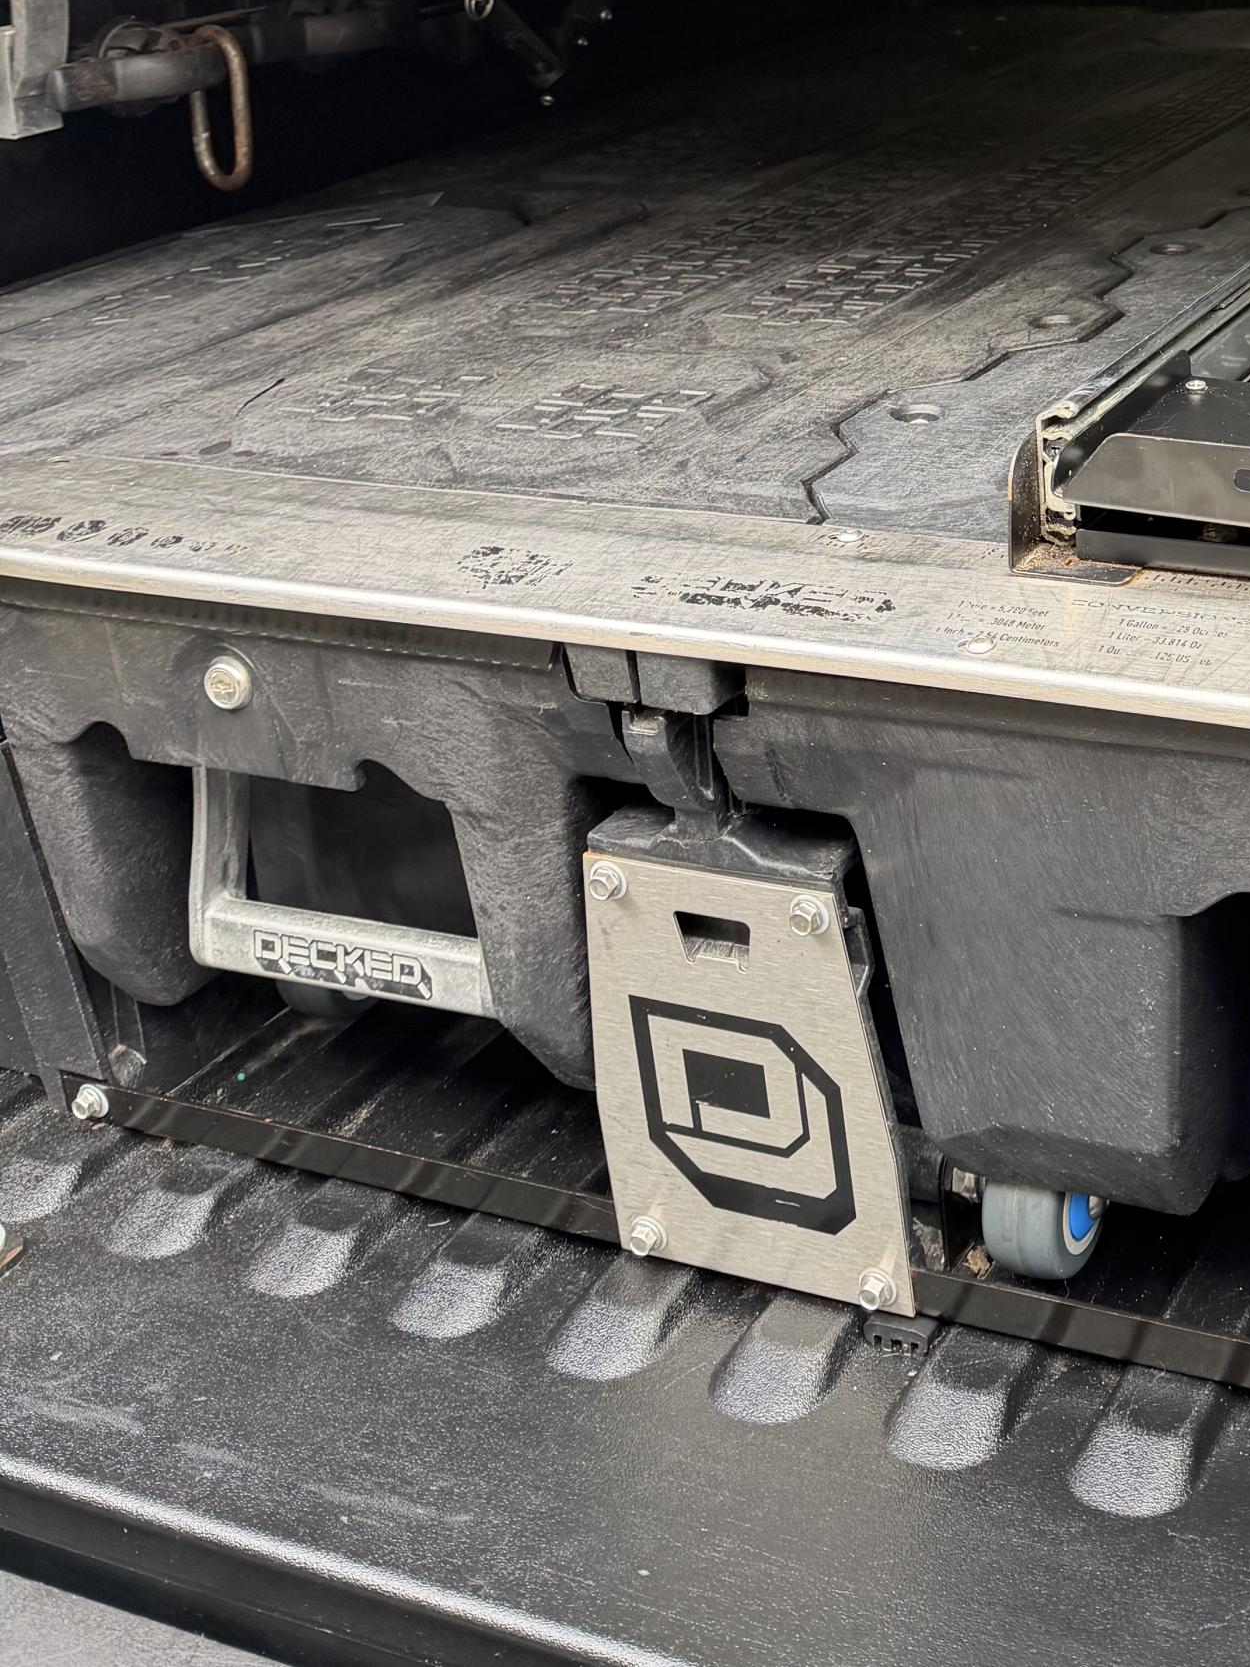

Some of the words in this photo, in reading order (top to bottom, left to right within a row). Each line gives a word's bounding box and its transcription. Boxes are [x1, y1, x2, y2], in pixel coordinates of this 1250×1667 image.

[1016, 621, 1046, 631] Meter
[1126, 619, 1159, 631] Gallon
[1000, 633, 1060, 648] Centimeters
[253, 929, 432, 1001] DECKED
